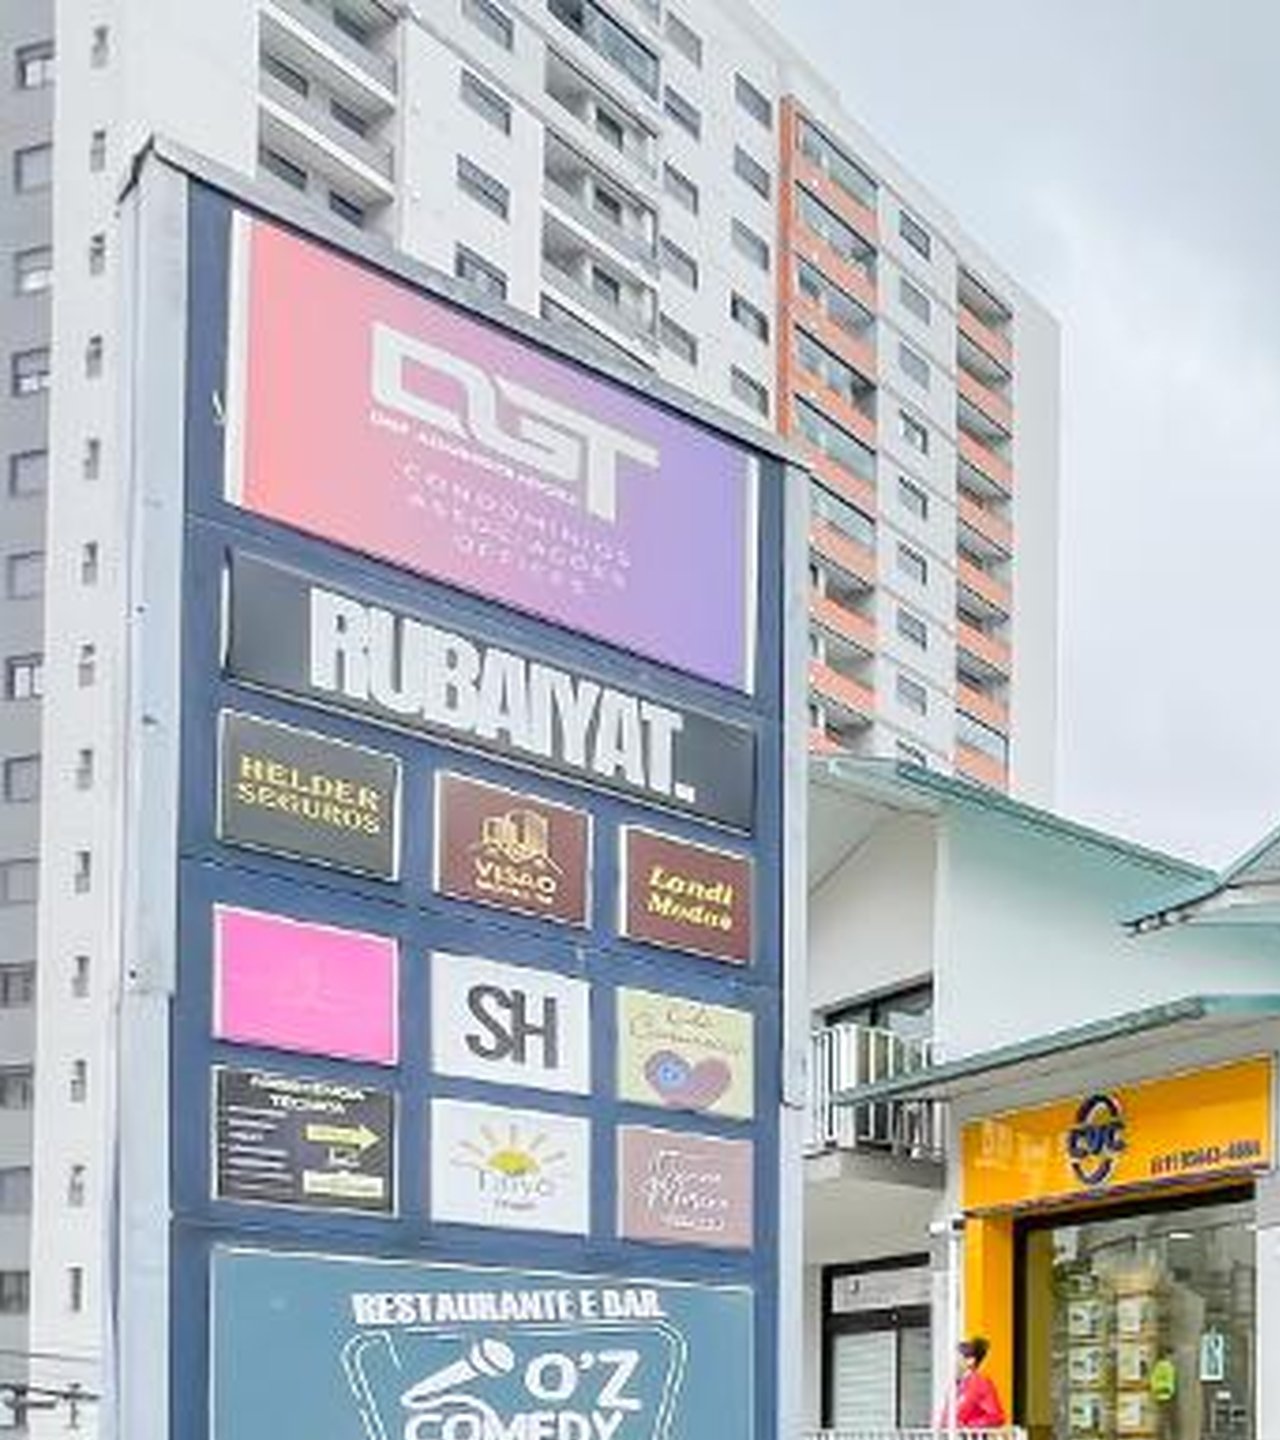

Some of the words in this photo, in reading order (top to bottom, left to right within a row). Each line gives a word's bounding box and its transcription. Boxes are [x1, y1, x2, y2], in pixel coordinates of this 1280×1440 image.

[237, 783, 380, 833] SEGUROS
[240, 756, 379, 811] HELDER
[465, 985, 558, 1069] SH
[1068, 1122, 1125, 1158] CVC
[351, 1292, 572, 1324] RESTAURANTE
[580, 1292, 597, 1317] E
[600, 1289, 666, 1317] BAR
